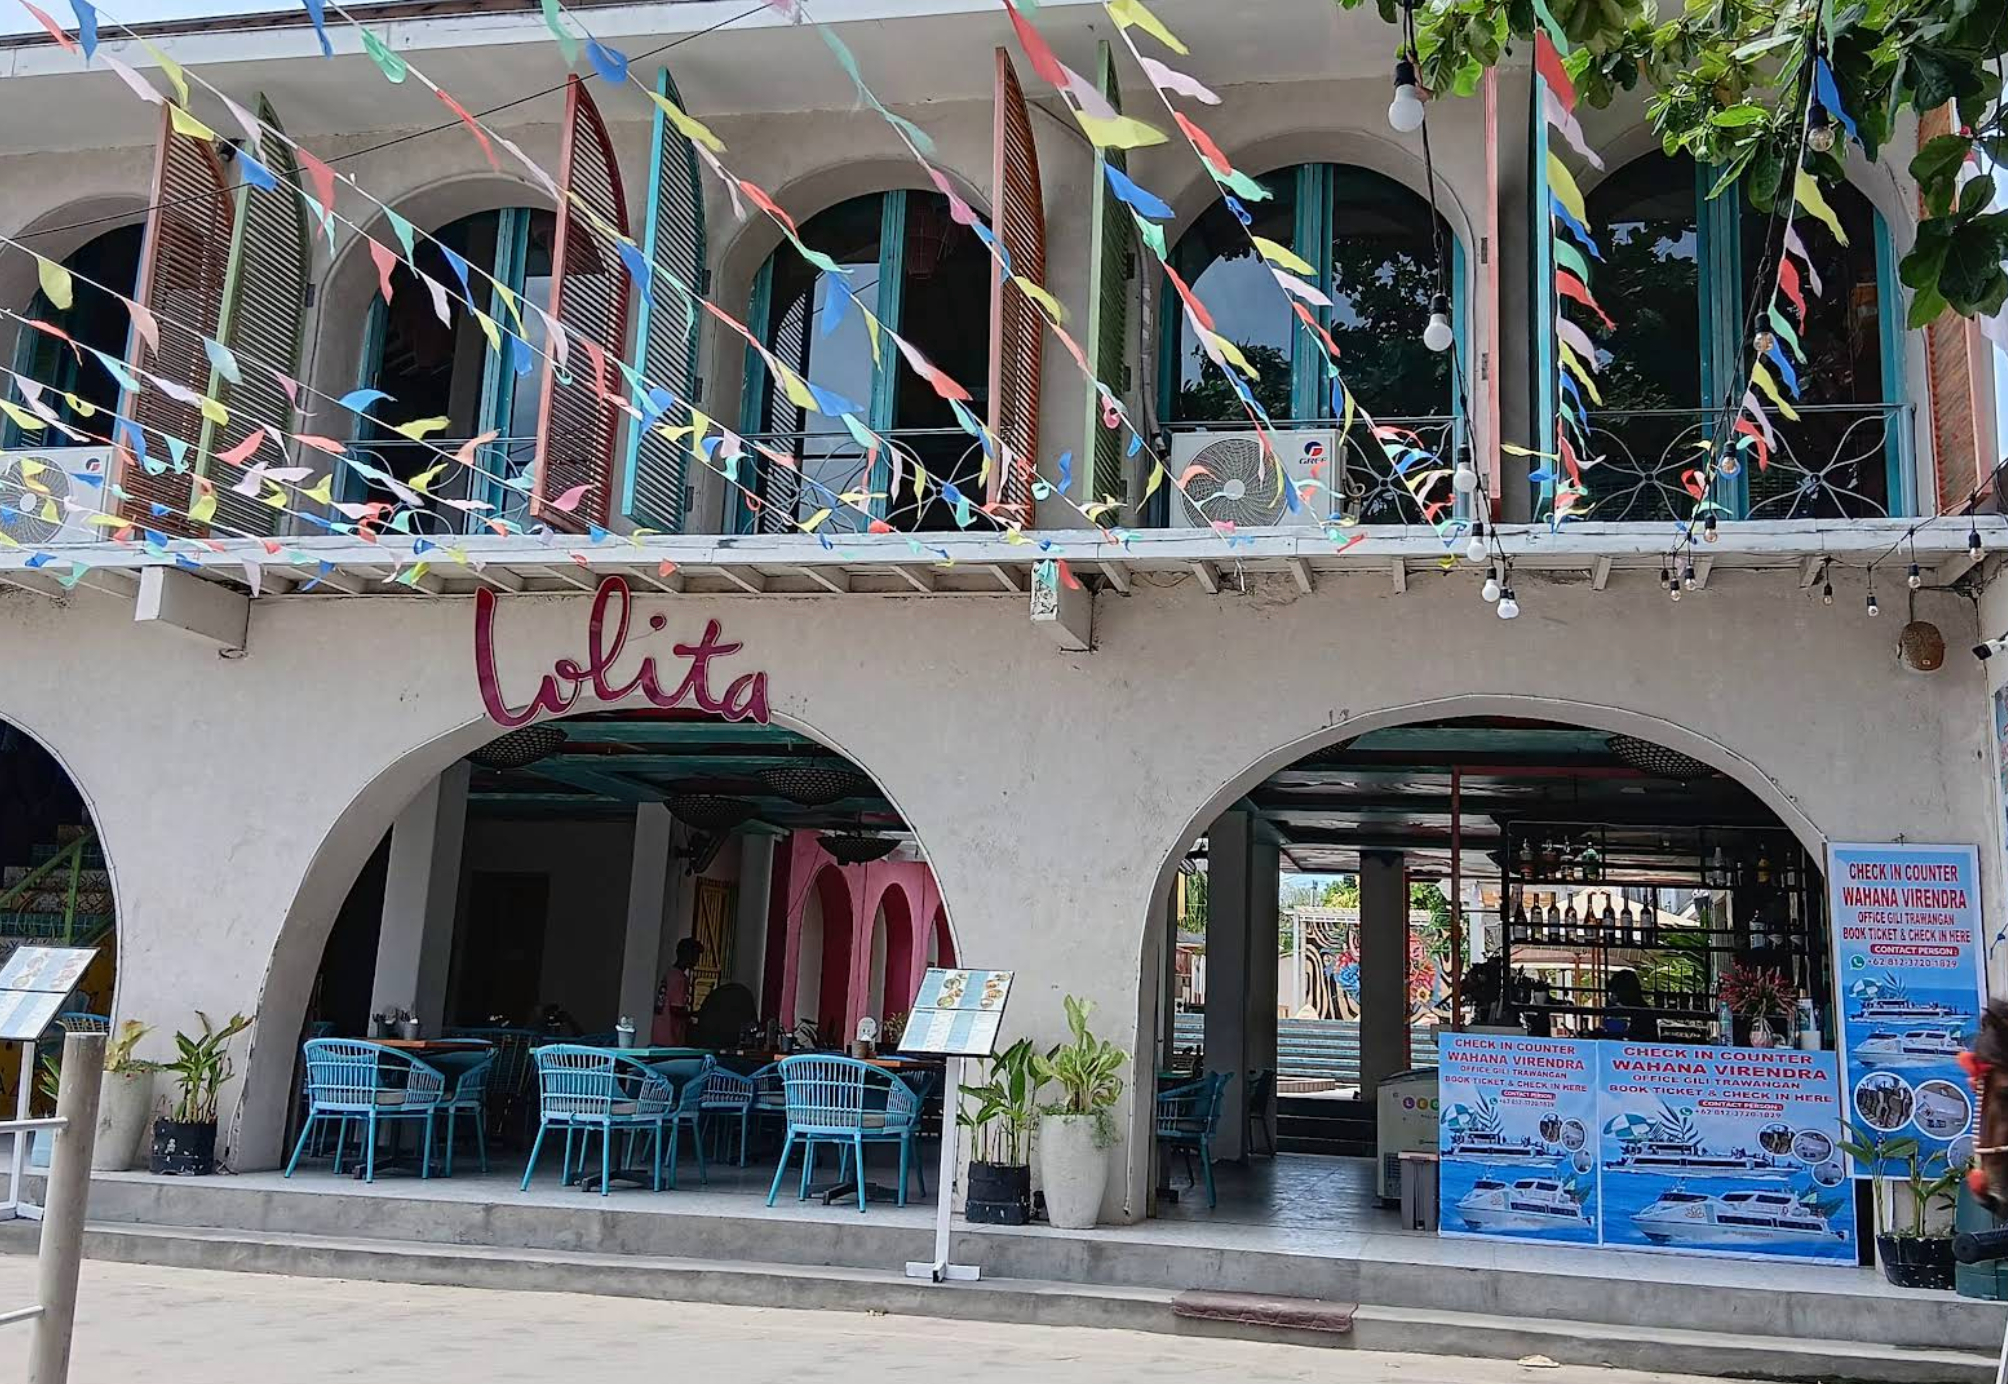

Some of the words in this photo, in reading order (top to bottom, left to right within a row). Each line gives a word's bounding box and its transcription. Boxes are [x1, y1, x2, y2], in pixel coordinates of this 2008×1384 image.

[475, 575, 770, 727] Lolita
[1849, 863, 1887, 880] CHECK
[1890, 864, 1901, 880] IN
[1905, 865, 1958, 882] COUNTER
[1843, 887, 1898, 907] WAHANA
[1902, 889, 1967, 908] VIRENDRA
[1858, 911, 1886, 924] OFFICE
[1887, 912, 1902, 924] GILI
[1905, 913, 1954, 926] TRAWANGAN
[1843, 927, 1866, 940] BOOK
[1868, 928, 1898, 941] TICKET
[1900, 929, 1906, 941] &
[1908, 929, 1936, 942] CHECK
[1938, 930, 1947, 942] IN
[1949, 931, 1971, 943] HERE
[1874, 945, 1916, 954] CONTACT
[1455, 1039, 1496, 1049] CHECK
[1501, 1041, 1513, 1050] IN
[1517, 1043, 1575, 1054] COUNTER
[1448, 1052, 1508, 1065] WAHANA
[1513, 1056, 1584, 1070] VIRENDRA
[1624, 1047, 1687, 1059] CHECK
[1695, 1050, 1713, 1060] IN
[1720, 1051, 1813, 1064] COUNTER
[1460, 1066, 1490, 1074] OFFICE
[1493, 1067, 1510, 1075] GILI
[1513, 1069, 1567, 1079] TRAWANGAN
[1613, 1060, 1707, 1075] WAHANA
[1715, 1065, 1827, 1080] VIRENDRA
[1473, 1077, 1504, 1086] TICKET
[1517, 1080, 1548, 1089] CHECK
[1563, 1084, 1587, 1092] HERE
[1632, 1074, 1679, 1083] OFFICE
[1684, 1077, 1710, 1085] GILI
[1715, 1079, 1800, 1090] TRAWANGAN
[1609, 1085, 1648, 1094] BOOK
[1653, 1087, 1703, 1096] TICKET
[1708, 1089, 1717, 1097] &
[1722, 1090, 1771, 1100] CHECK
[1776, 1092, 1790, 1100] IN
[1796, 1094, 1834, 1103] HERE
